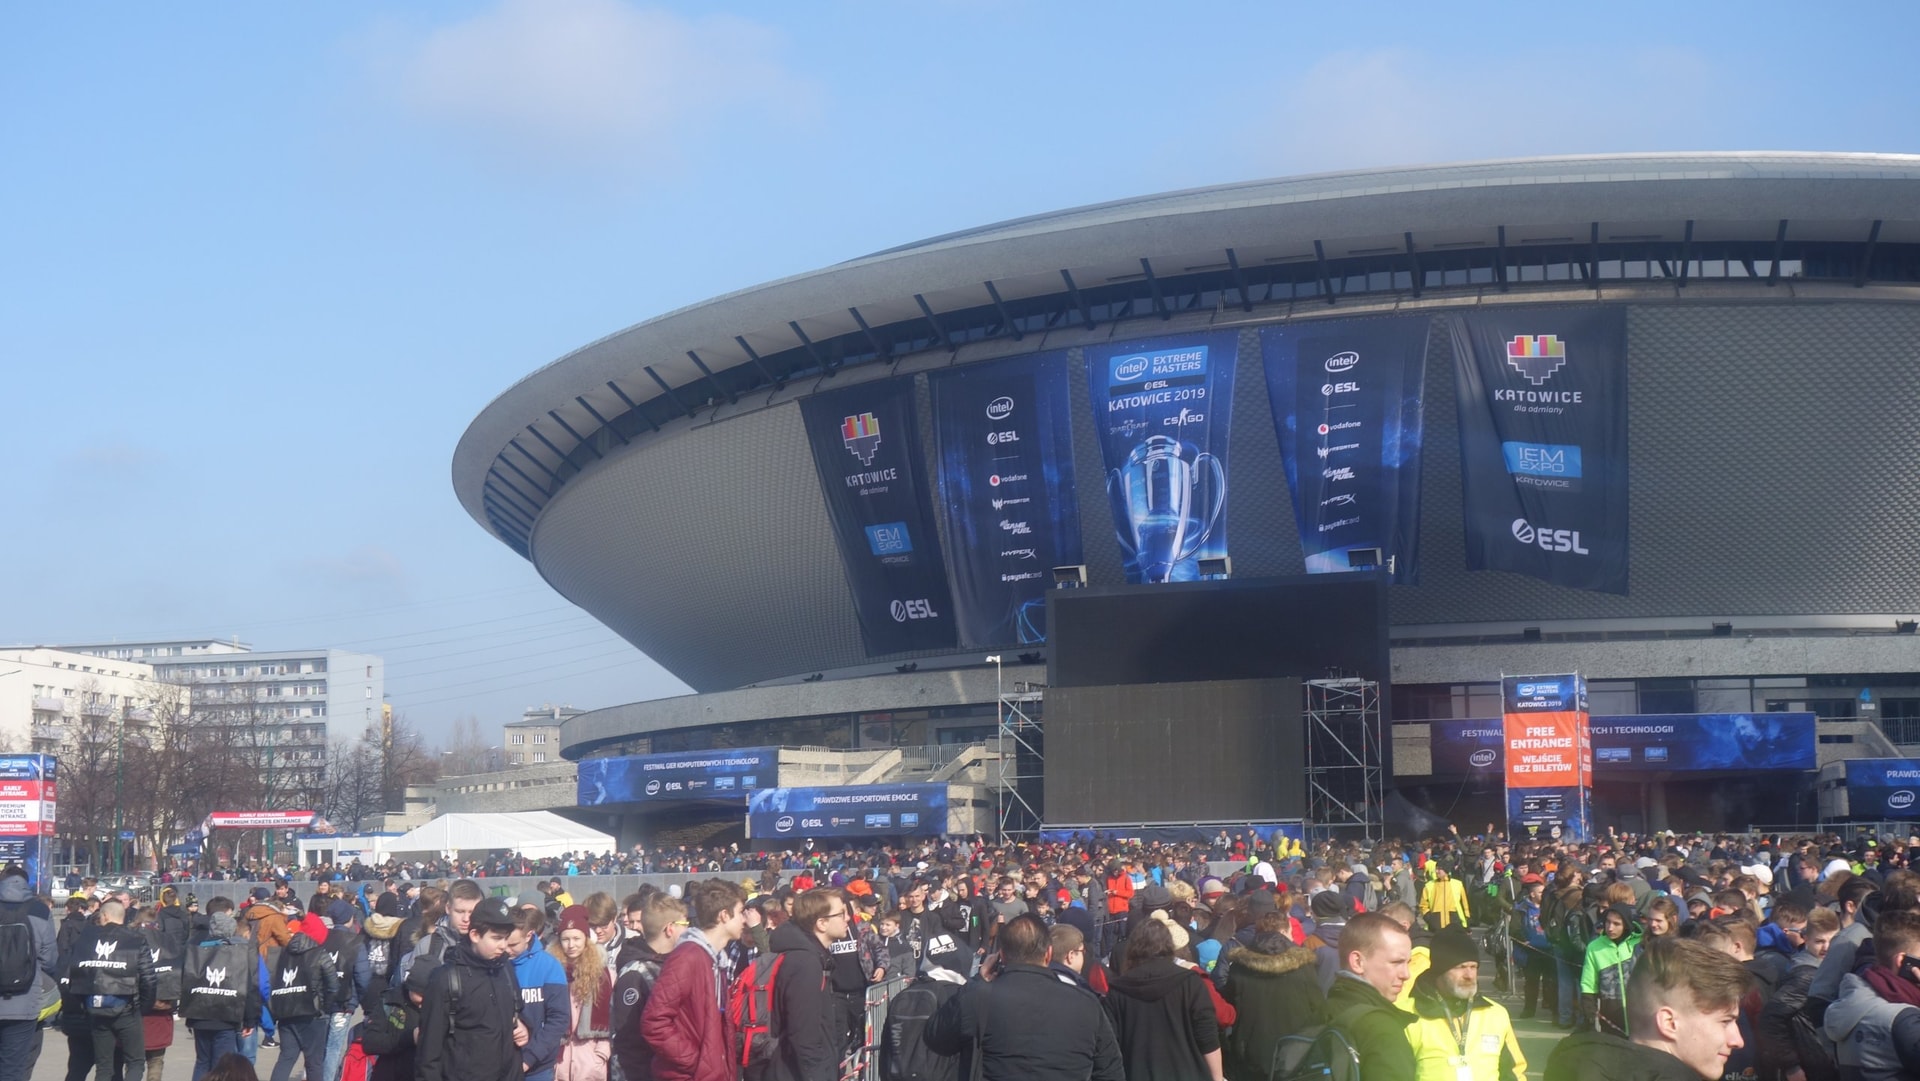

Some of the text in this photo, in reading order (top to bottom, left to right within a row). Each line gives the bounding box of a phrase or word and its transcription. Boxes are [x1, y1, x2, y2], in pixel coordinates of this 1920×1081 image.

[1153, 351, 1202, 366] EXTREME
[1328, 357, 1354, 369] intel
[1119, 362, 1143, 375] intel
[1152, 361, 1201, 375] MASTERS
[1152, 380, 1169, 389] ESL
[1334, 382, 1360, 393] ESL
[1108, 388, 1206, 413] KATOWICE 2019
[1494, 389, 1583, 404] KATOWICE
[990, 402, 1010, 414] intel
[1513, 404, 1564, 415] dla odmiany
[1330, 421, 1362, 431] vodafone
[998, 430, 1020, 443] ESL
[1519, 447, 1564, 464] IEM
[1519, 460, 1565, 473] EXPO
[845, 468, 897, 488] KATOWICE
[1001, 474, 1028, 482] vodafone
[1515, 475, 1570, 488] KATOWICE
[873, 527, 900, 542] IEM
[878, 540, 903, 551] EXPO
[1537, 527, 1589, 555] ESL
[905, 599, 938, 619] ESL
[1860, 687, 1872, 702] 4
[1462, 729, 1504, 737] FESTIWAL
[1614, 725, 1674, 734] TECHNOLOGII
[1526, 727, 1555, 736] FREE
[1510, 738, 1572, 749] ENTRANCE
[1472, 754, 1493, 762] intel
[1522, 753, 1562, 764] WEJŚCIE
[1513, 765, 1530, 773] BEZ
[1532, 762, 1572, 773] BILETÓW
[813, 793, 919, 804] PRAWDZIWE ESPORTOWE EMOCJE
[1892, 794, 1911, 803] intel
[809, 819, 823, 827] ESL
[191, 987, 237, 998] PREDATOR
